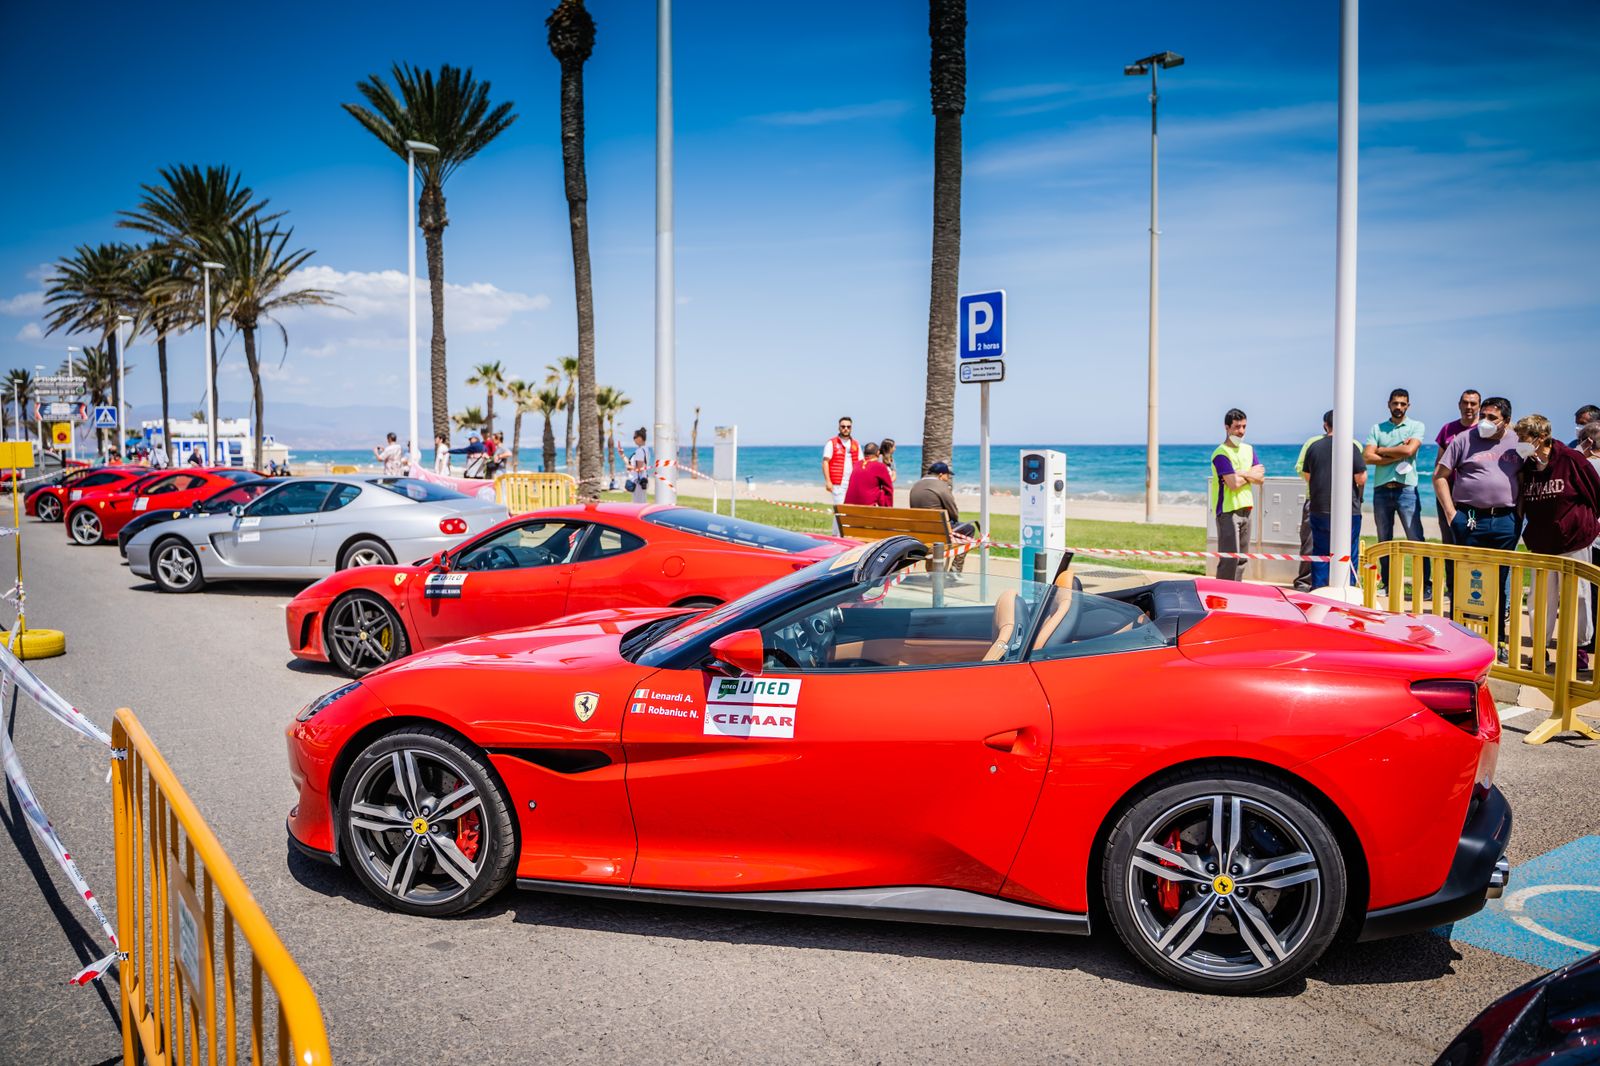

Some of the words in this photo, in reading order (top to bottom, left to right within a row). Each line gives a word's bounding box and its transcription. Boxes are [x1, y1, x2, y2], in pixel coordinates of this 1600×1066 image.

[968, 301, 994, 352] P
[983, 342, 1000, 350] horas
[740, 681, 790, 695] UNED
[651, 691, 683, 702] Lenardi
[684, 694, 693, 703] A.
[648, 705, 688, 717] Robaniuc
[689, 710, 699, 719] N.
[712, 713, 793, 727] CEMAR
